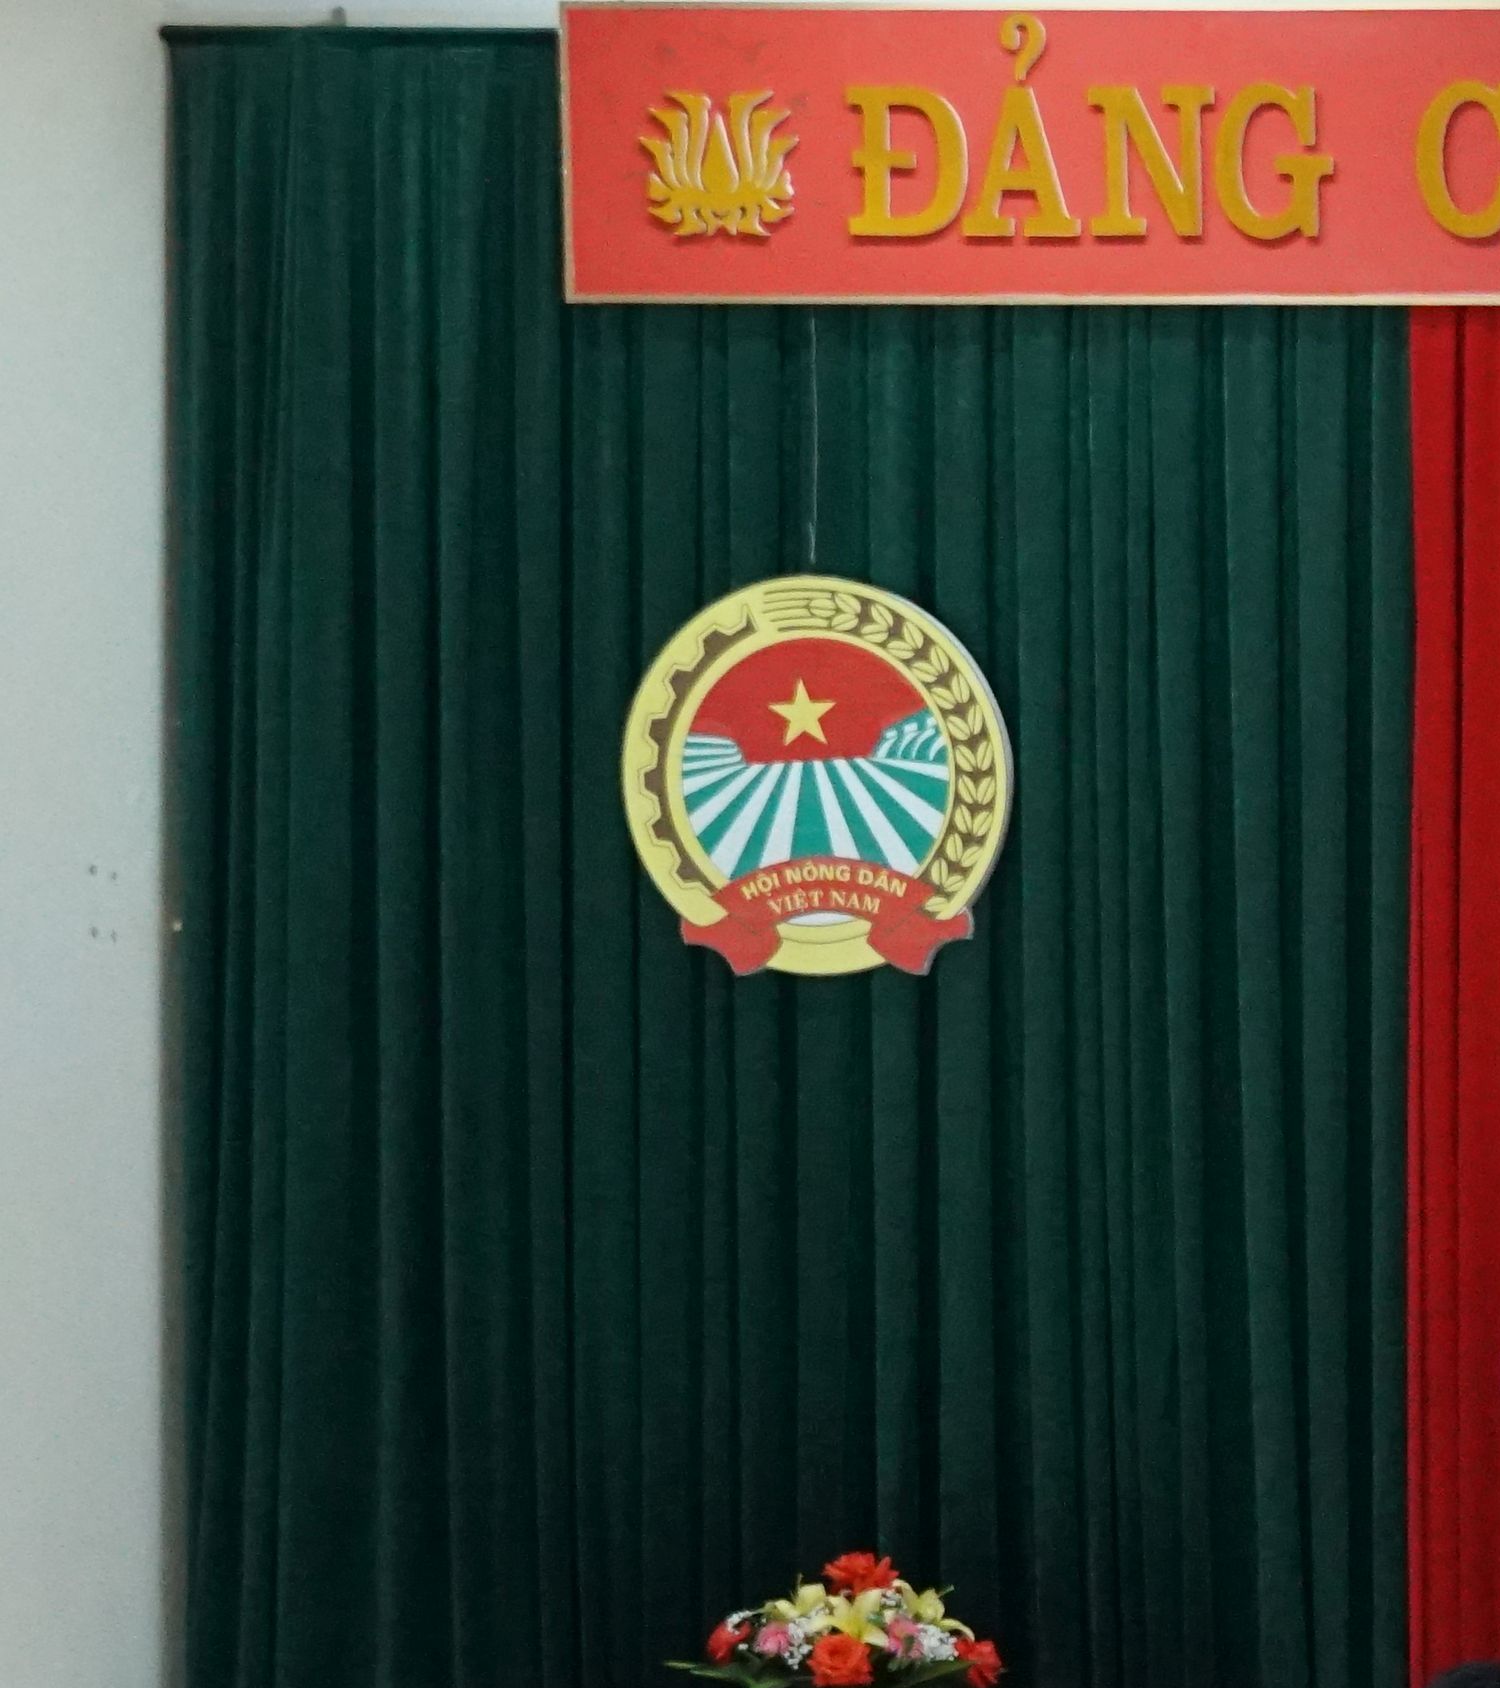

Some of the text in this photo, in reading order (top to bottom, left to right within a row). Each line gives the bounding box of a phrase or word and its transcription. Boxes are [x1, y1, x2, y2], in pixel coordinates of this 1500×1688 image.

[846, 16, 1335, 239] ĐẢNG
[740, 861, 907, 900] HỘI NÔNG DÂN
[767, 888, 880, 915] VIỆT NAM
